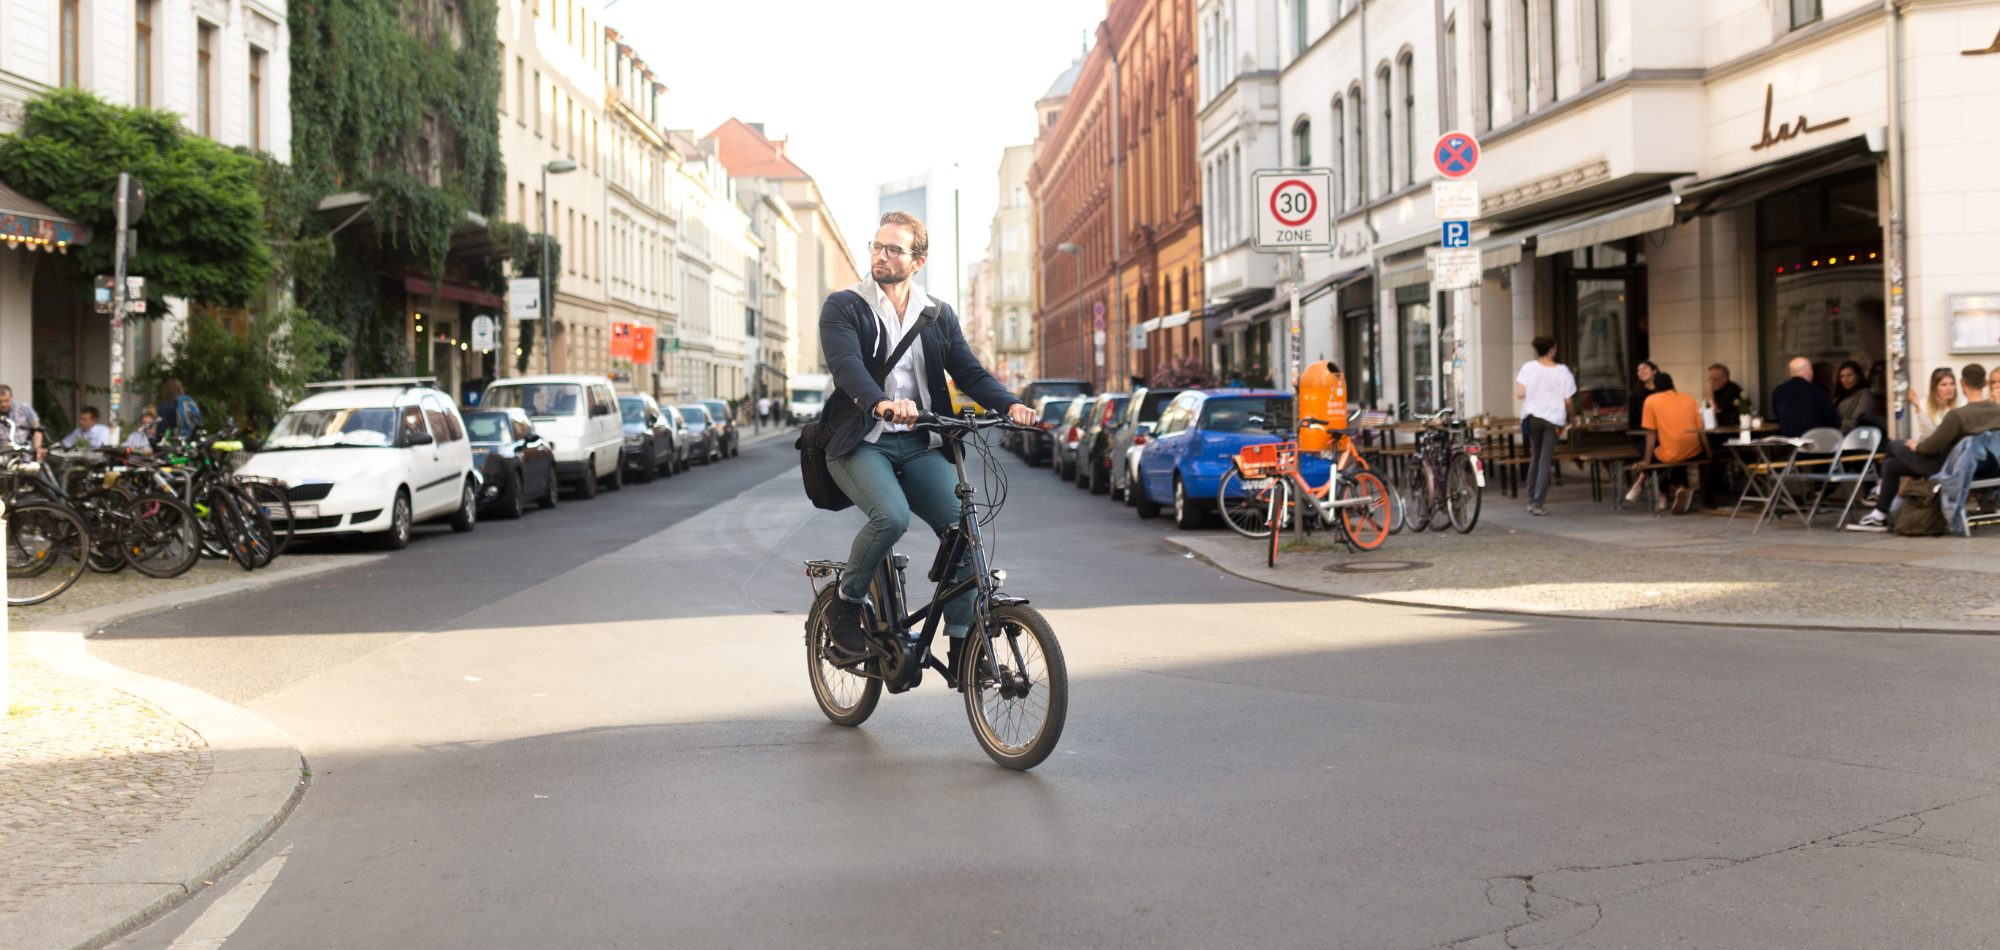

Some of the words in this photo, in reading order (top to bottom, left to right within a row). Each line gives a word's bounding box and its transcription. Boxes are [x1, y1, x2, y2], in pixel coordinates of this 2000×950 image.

[1750, 82, 1850, 152] bar
[1280, 192, 1307, 214] 30
[1276, 229, 1312, 242] ZONE
[1447, 223, 1463, 246] P
